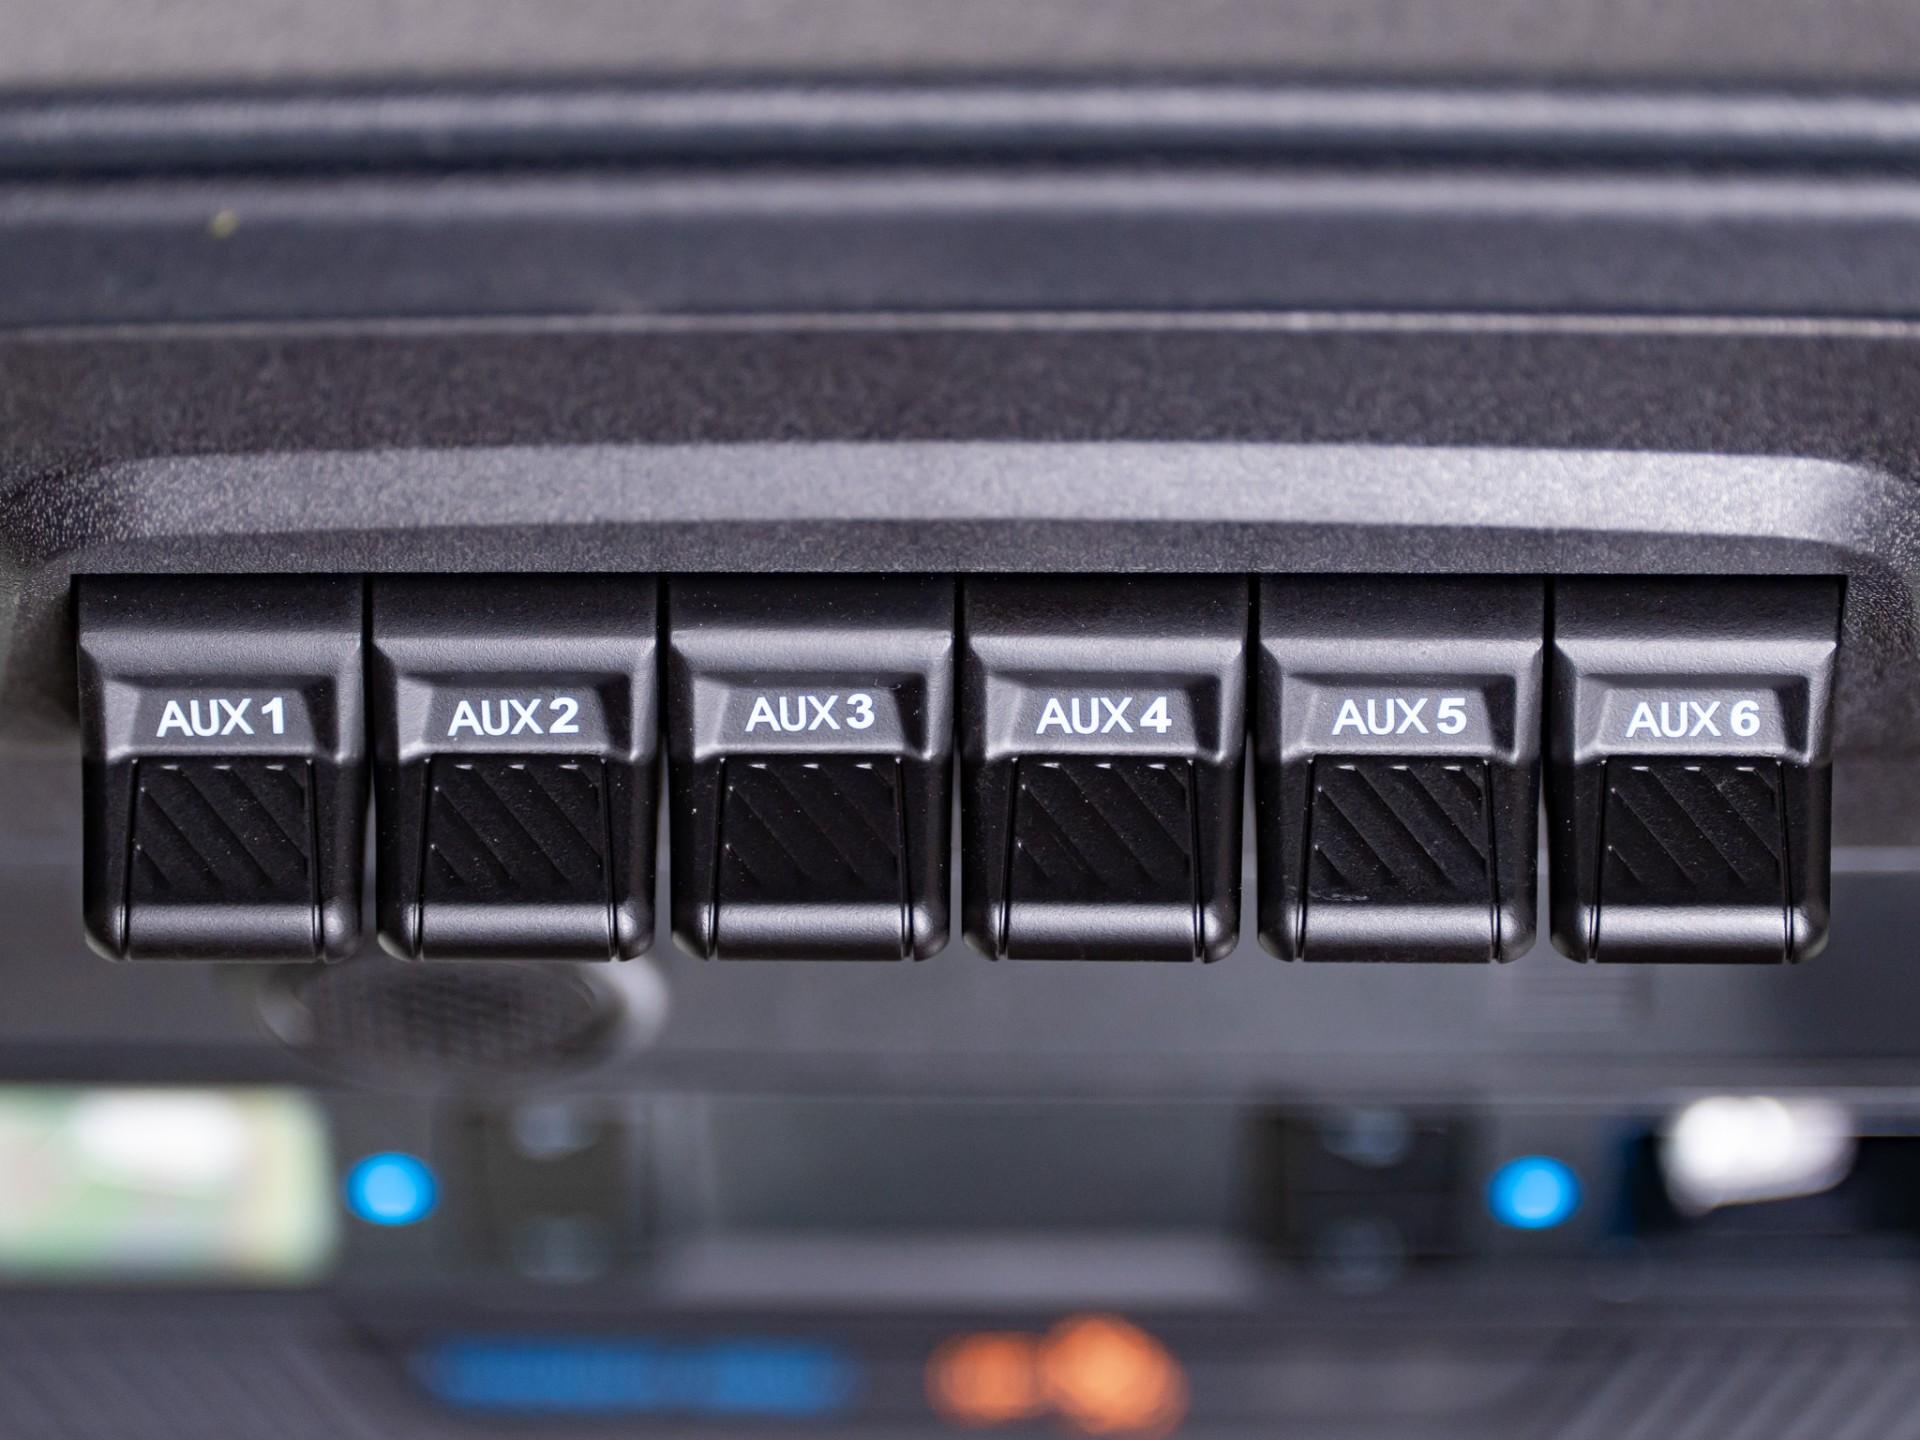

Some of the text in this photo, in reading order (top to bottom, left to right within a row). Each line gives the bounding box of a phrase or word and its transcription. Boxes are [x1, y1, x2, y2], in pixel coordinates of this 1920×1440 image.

[156, 697, 285, 738] AUX 1
[447, 696, 580, 737] AUX 2
[744, 693, 876, 733] AUX 3
[1035, 695, 1173, 735] AUX 4
[1331, 696, 1468, 736] AUX 5
[1625, 699, 1761, 738] AUX 6
